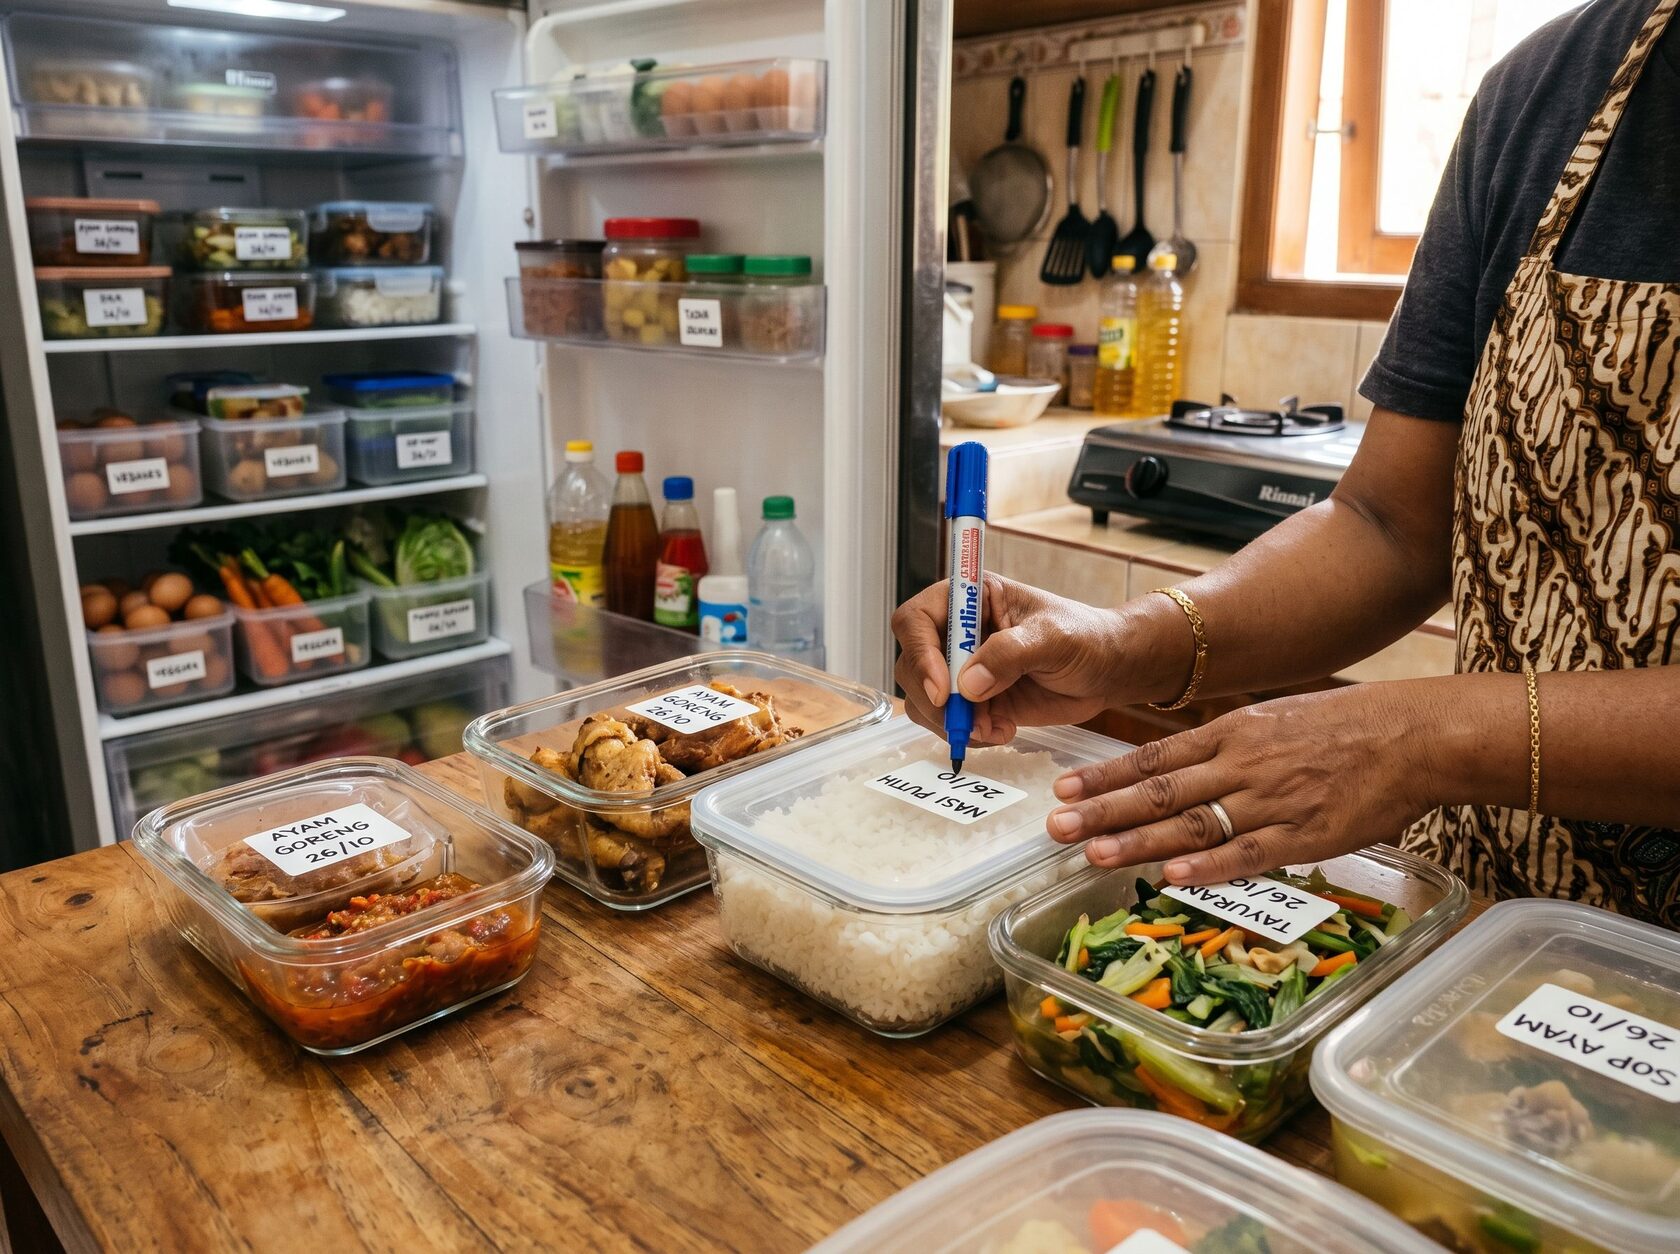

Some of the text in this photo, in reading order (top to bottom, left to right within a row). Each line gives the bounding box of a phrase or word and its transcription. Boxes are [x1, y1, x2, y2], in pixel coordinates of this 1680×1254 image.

[1259, 485, 1316, 507] Rinnai
[959, 585, 978, 654] Artline
[662, 695, 727, 722] GORENG
[688, 690, 736, 709] AYAM
[937, 772, 1004, 799] 26/10
[934, 796, 988, 818] NASI
[271, 816, 338, 842] AYAM
[275, 821, 370, 856] GORENG
[305, 836, 375, 863] 26/10
[1567, 1005, 1675, 1050] 26/10
[1513, 1014, 1678, 1088] SOP AYAM
